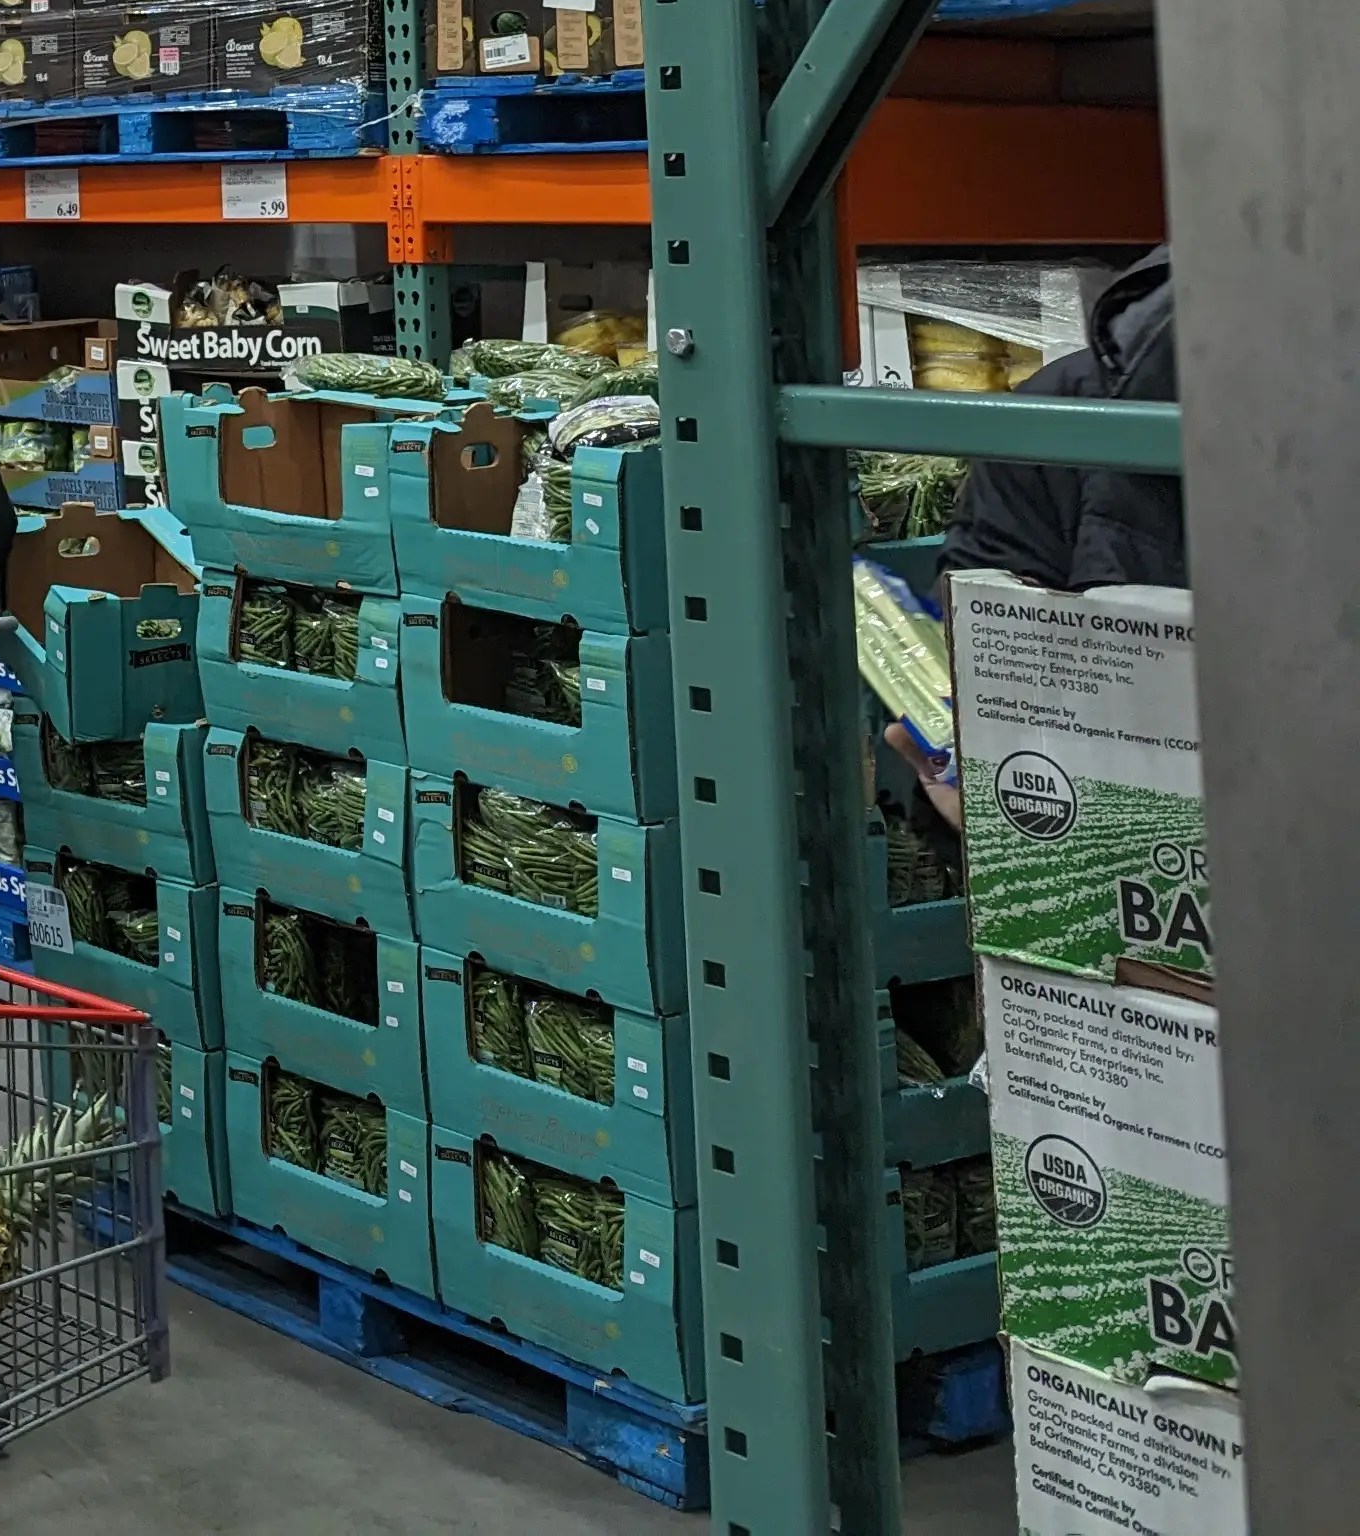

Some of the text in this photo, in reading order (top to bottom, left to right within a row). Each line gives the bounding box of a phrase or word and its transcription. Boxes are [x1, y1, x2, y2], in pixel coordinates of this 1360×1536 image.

[57, 203, 78, 216] 6.49
[260, 201, 285, 216] 5.99
[137, 328, 322, 366] Sweet Baby Corn
[79, 391, 112, 408] SPROUTS
[81, 481, 114, 498] SPROUTS
[970, 600, 1085, 628] ORGANICALLY
[1091, 615, 1159, 639] GROWN
[139, 648, 187, 664] SELECTS
[971, 623, 1164, 661] Grown, packed and distributed by:
[972, 638, 1133, 670] Cal-Organic Farms, a division
[973, 653, 1134, 685] of Grimmway Enterprises, Inc.
[974, 666, 1099, 695] Bakersfield, CA 93380
[976, 694, 1076, 720] Certified Organic by
[977, 708, 1161, 747] California Certified Organic Farmers
[1012, 770, 1058, 796] USDA
[1008, 793, 1065, 819] ORGANIC
[1001, 975, 1188, 1040] ORGANICALLY GROWN
[1112, 1030, 1172, 1056] distributed
[1005, 1042, 1129, 1088] Bakersfield, CA 93380
[1043, 1152, 1088, 1185] USDA
[1038, 1177, 1095, 1209] ORGANIC
[1027, 1365, 1226, 1457] ORGANICALLY GROWN
